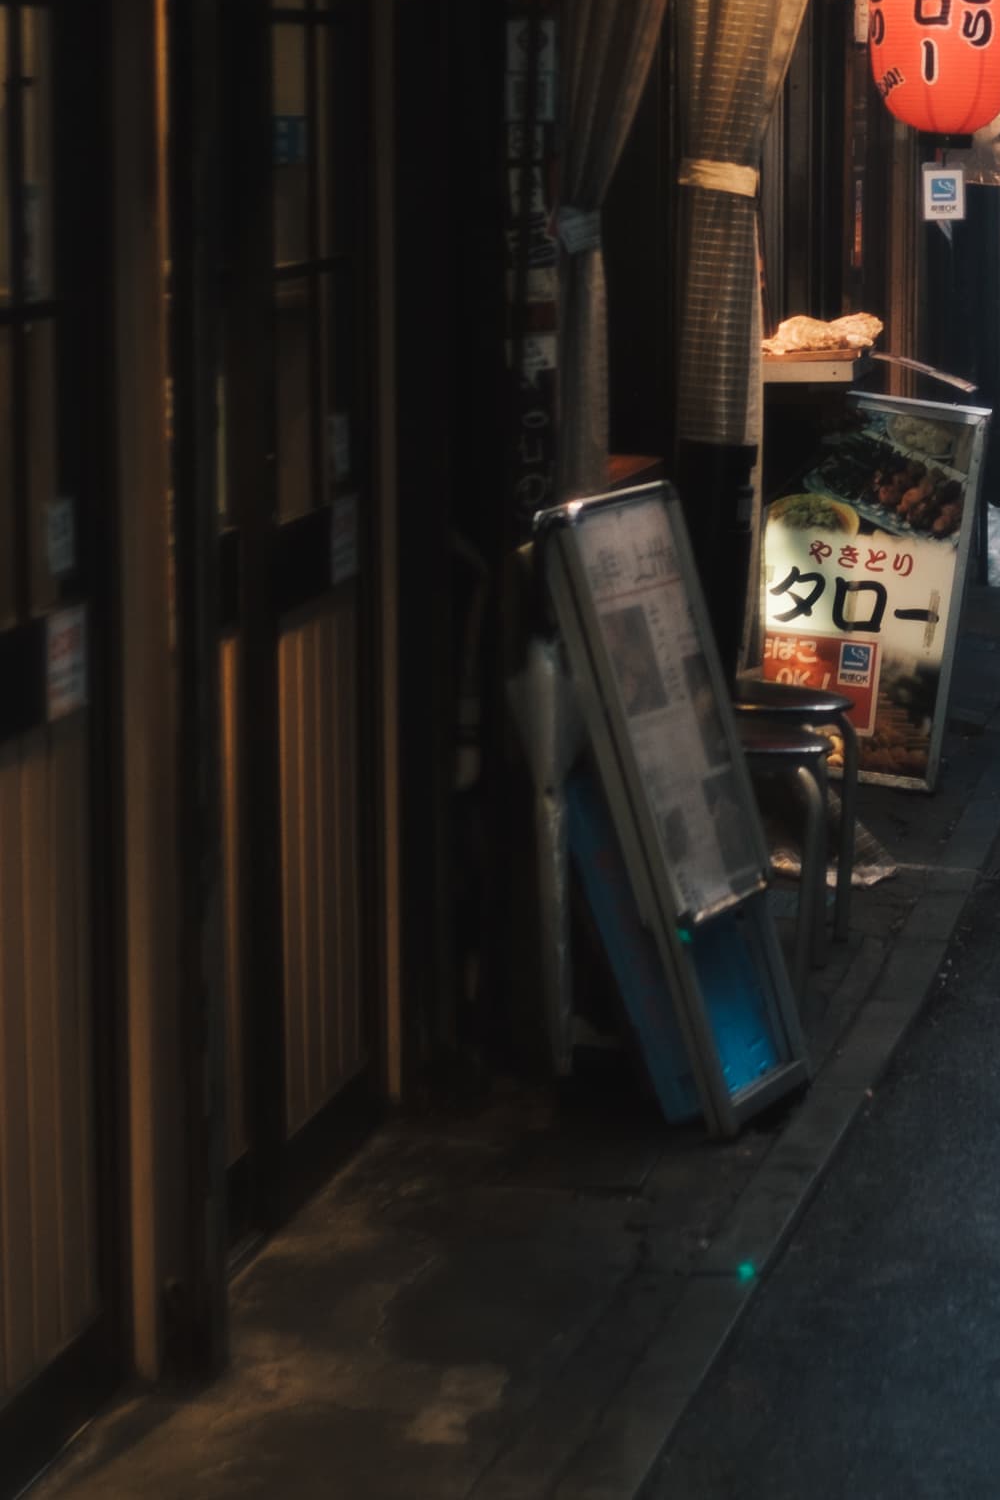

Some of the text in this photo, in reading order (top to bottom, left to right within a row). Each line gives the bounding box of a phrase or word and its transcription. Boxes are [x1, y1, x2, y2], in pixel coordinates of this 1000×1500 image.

[808, 539, 915, 577] やきとり
[769, 566, 940, 633] タロー
